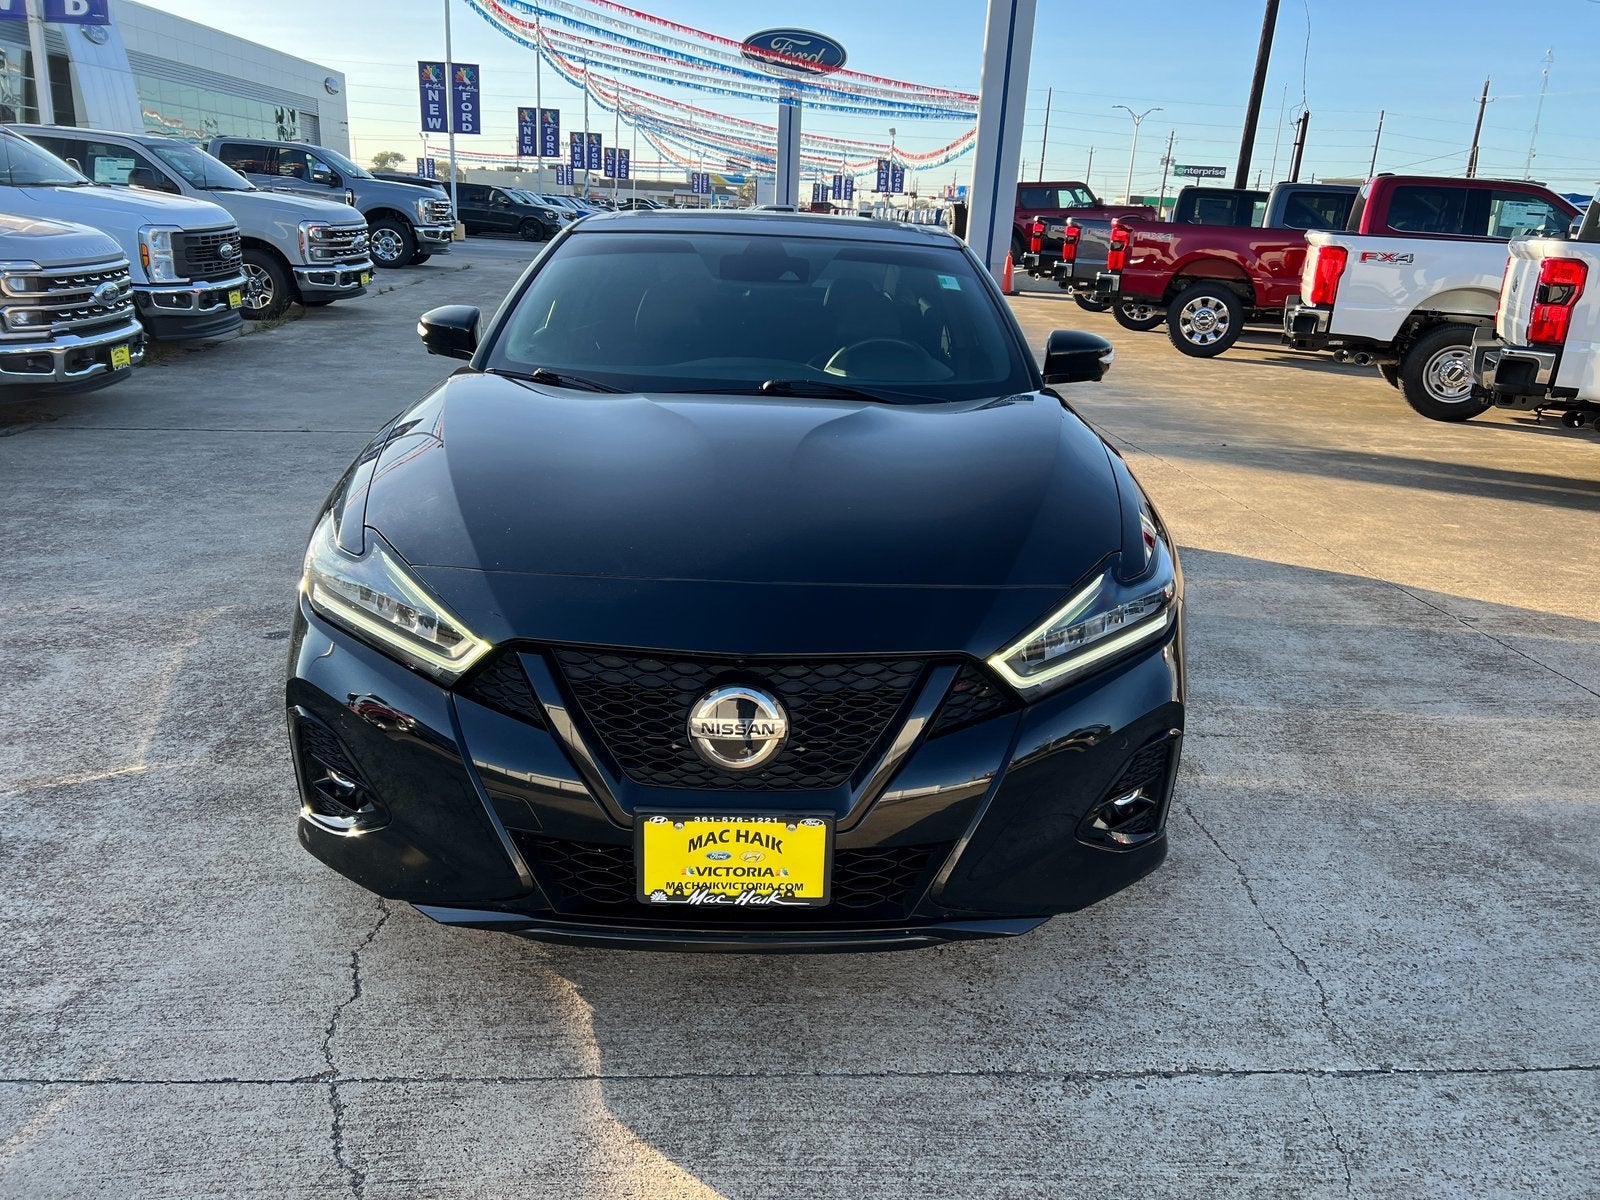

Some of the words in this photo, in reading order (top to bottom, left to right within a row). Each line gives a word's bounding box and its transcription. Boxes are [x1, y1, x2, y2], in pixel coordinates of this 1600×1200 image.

[767, 37, 826, 63] Ford
[427, 89, 442, 129] NEW
[461, 92, 473, 132] FORD
[523, 126, 533, 154] NEW
[546, 128, 555, 156] FORD
[574, 146, 582, 168] NEW
[1177, 167, 1226, 176] enterprise
[1137, 231, 1175, 241] FX4
[1359, 251, 1414, 264] FX4
[700, 722, 776, 735] NISSAN
[687, 829, 731, 853] MAC
[735, 829, 784, 854] HAIK
[695, 866, 775, 877] VICTORIA
[687, 888, 730, 905] Mac
[734, 889, 783, 906] Haik
